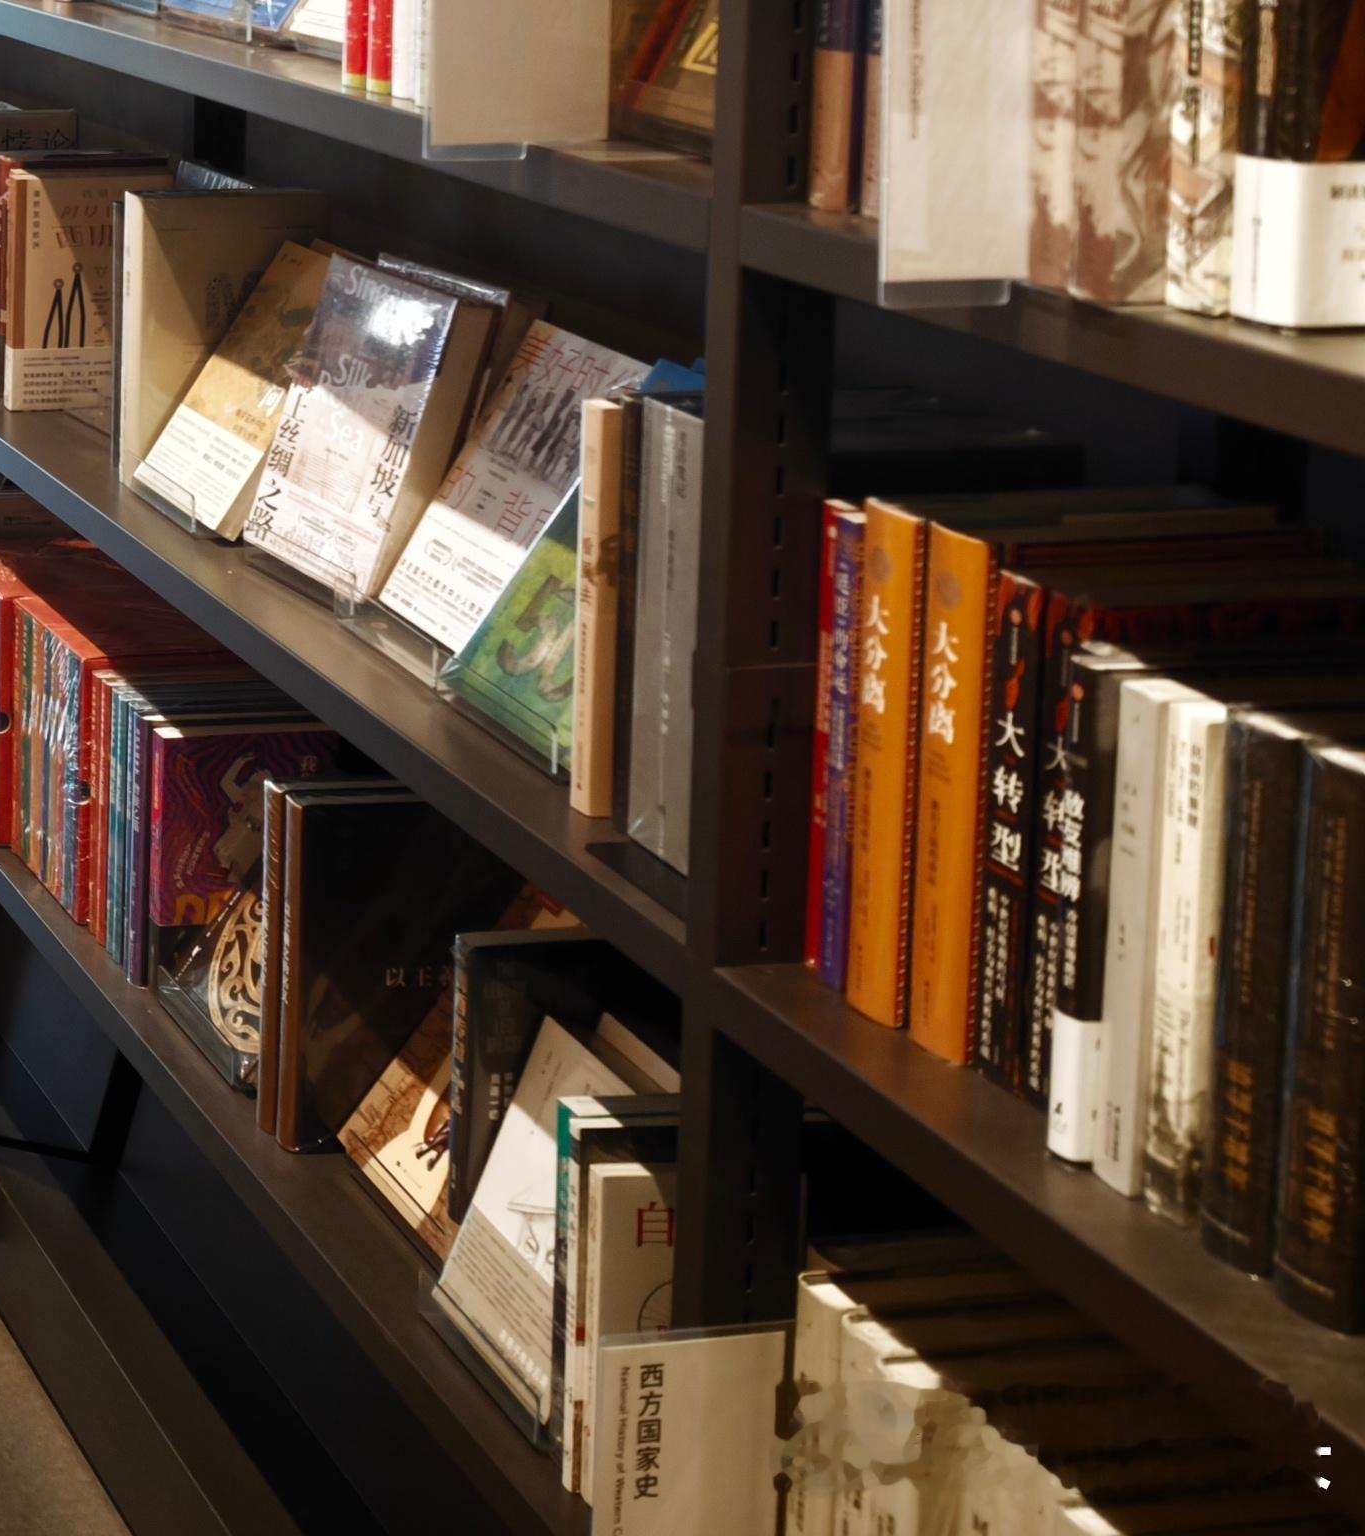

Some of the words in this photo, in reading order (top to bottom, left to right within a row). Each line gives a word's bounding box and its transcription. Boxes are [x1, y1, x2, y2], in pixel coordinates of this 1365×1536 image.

[323, 414, 365, 454] Sea
[990, 712, 1026, 872] 大转型
[619, 1366, 631, 1421] National
[616, 1424, 628, 1461] History
[634, 1363, 665, 1501] 西方国家史
